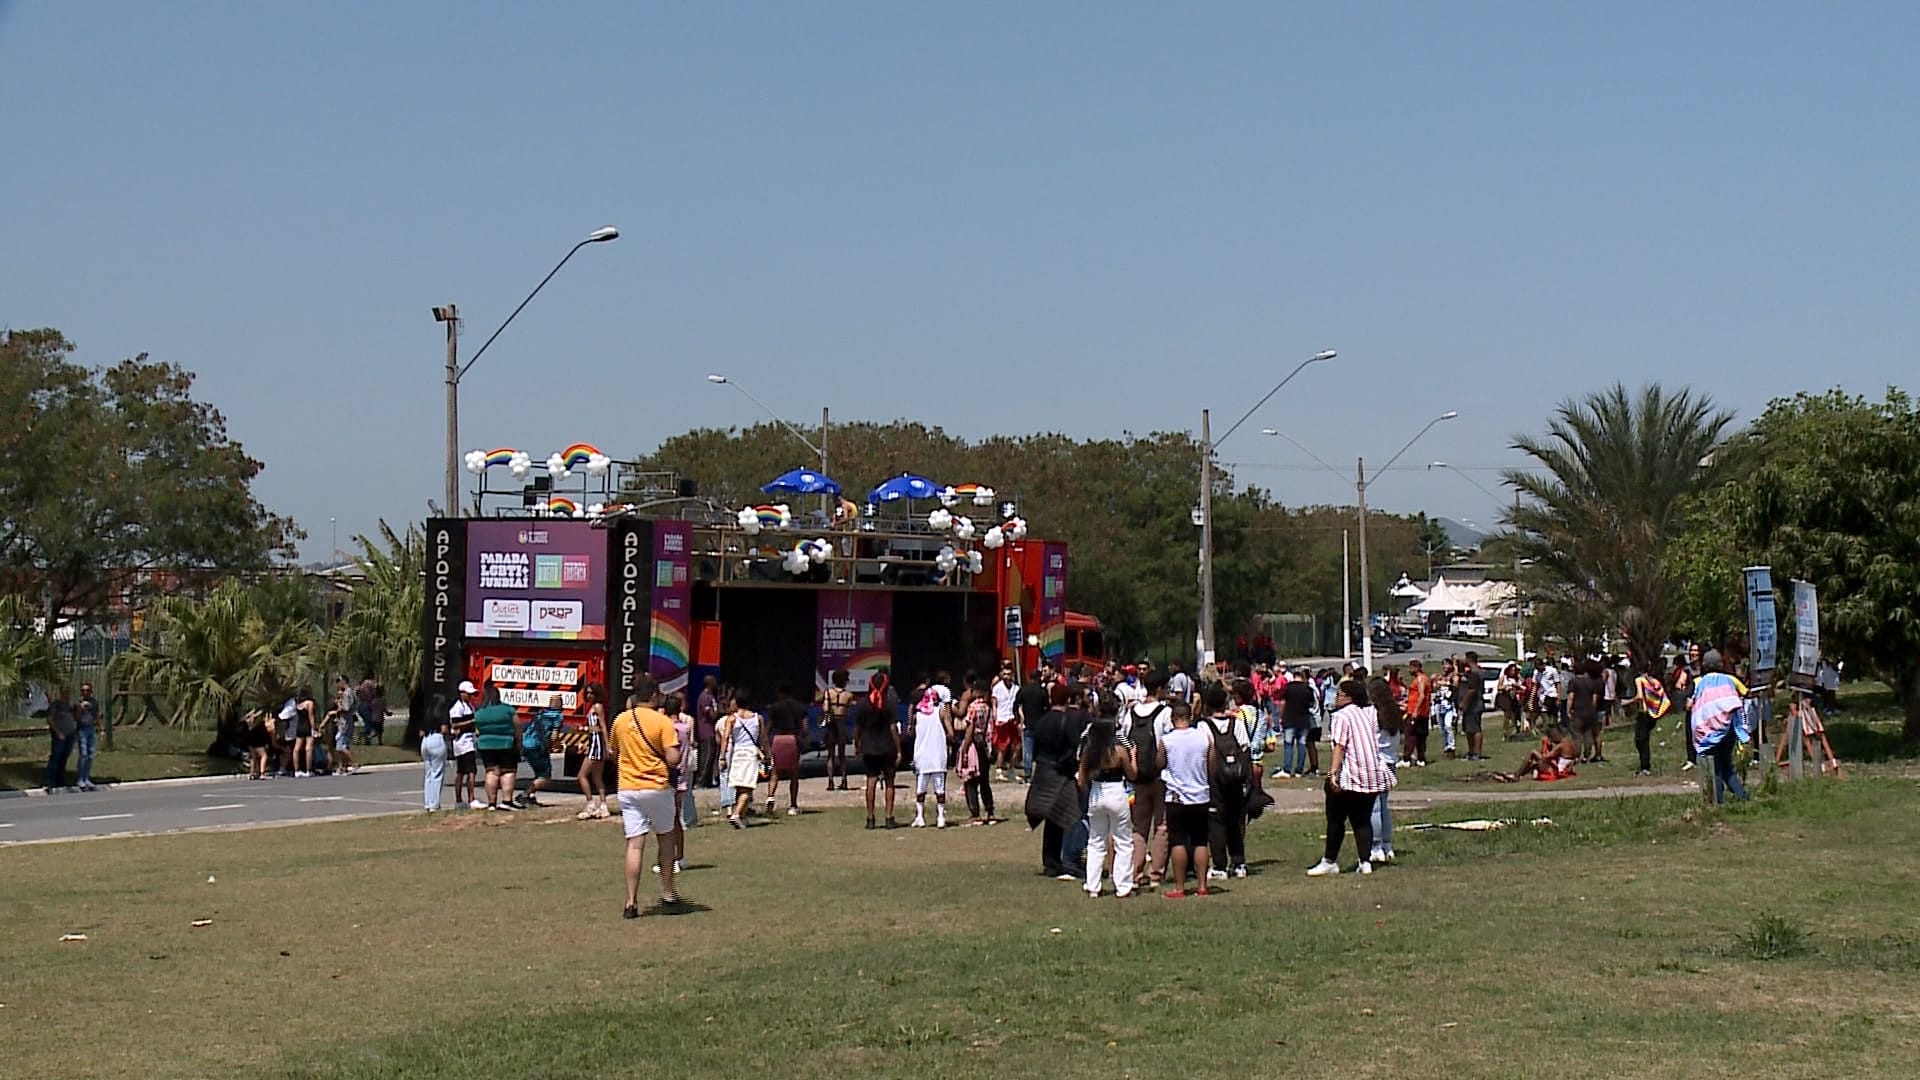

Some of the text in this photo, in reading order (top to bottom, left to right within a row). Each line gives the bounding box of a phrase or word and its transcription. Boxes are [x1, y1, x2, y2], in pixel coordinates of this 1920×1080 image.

[480, 553, 529, 564] PARADA
[435, 530, 449, 682] APOCALIPSE
[540, 607, 573, 619] DROP
[621, 532, 638, 690] APOCALIPSE
[494, 666, 550, 681] COMPRIMENTO
[503, 690, 540, 705] ARGURA
